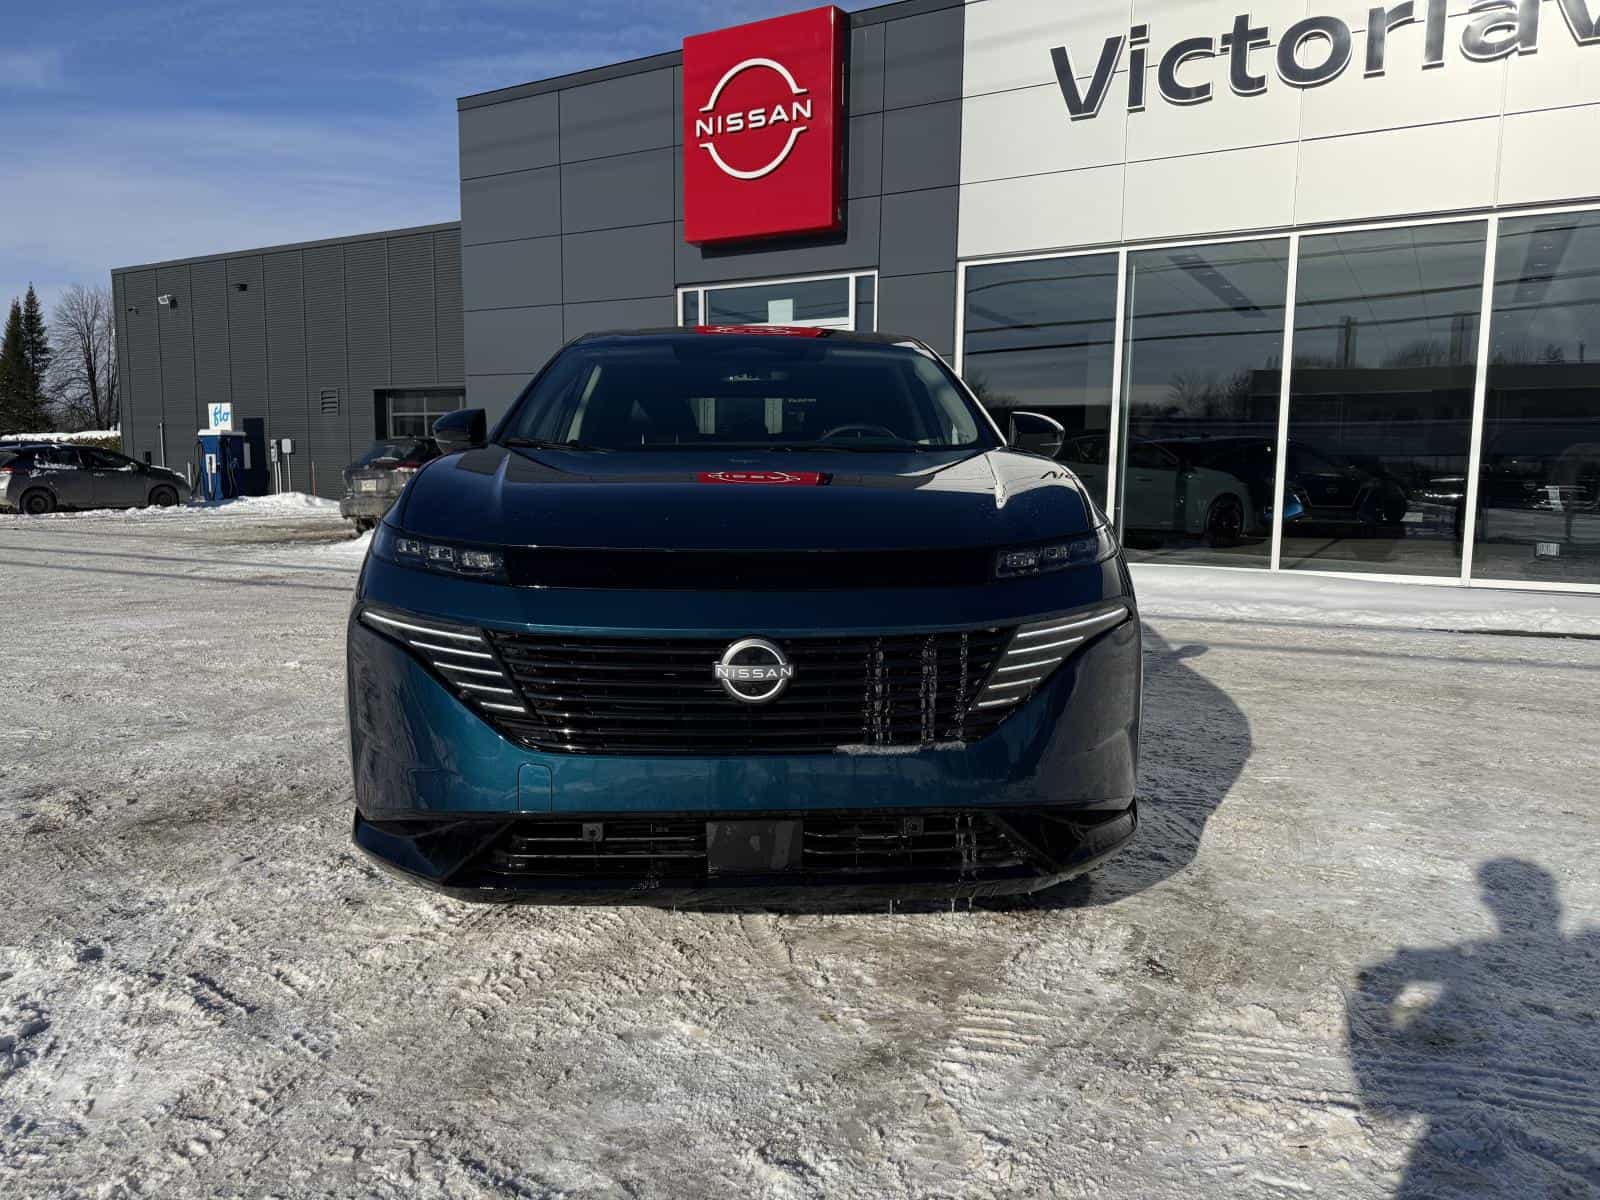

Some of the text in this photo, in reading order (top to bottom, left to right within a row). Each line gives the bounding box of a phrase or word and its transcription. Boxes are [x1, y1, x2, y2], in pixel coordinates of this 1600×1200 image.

[696, 99, 811, 137] NISSAN
[213, 404, 230, 427] flo
[716, 666, 792, 679] NISSAN
